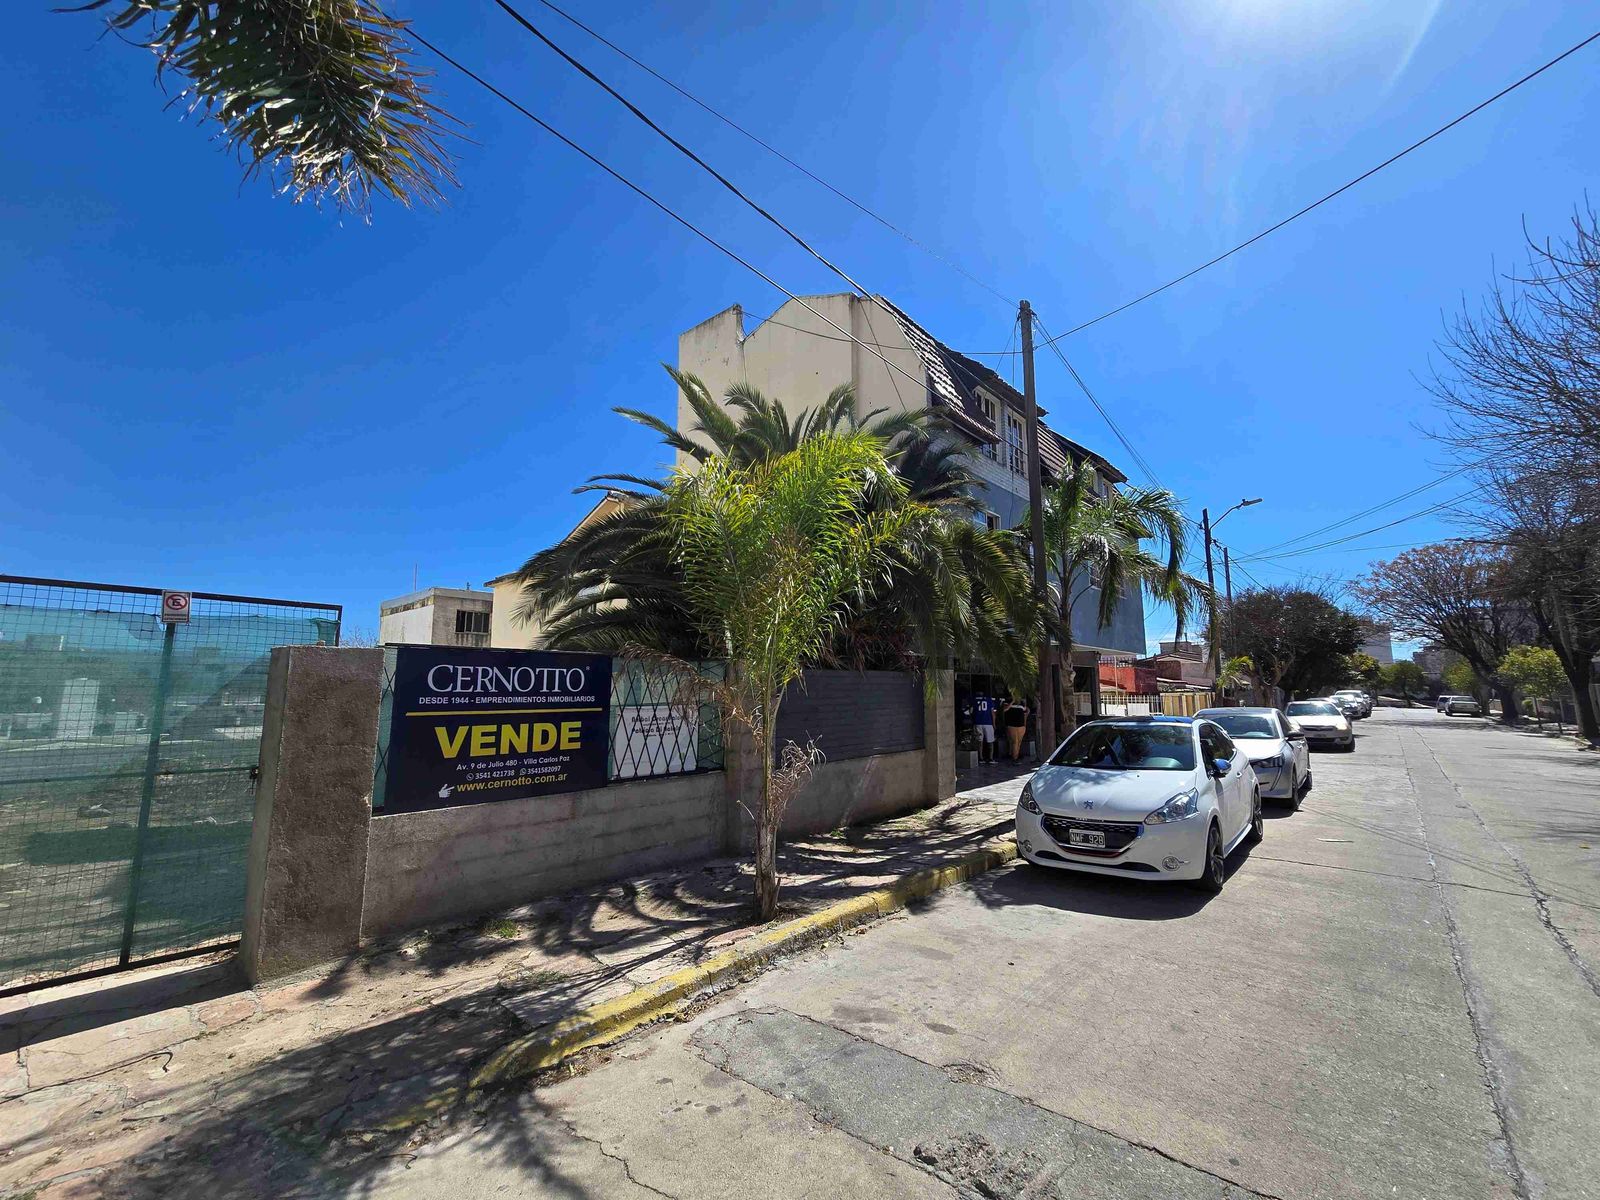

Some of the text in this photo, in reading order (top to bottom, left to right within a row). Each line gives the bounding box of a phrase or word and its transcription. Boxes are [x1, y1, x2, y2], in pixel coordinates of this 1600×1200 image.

[427, 664, 585, 693] CERNOTTO
[419, 697, 449, 705] DESDE
[451, 696, 469, 704] 1944
[475, 696, 546, 704] EMPRENDIMIENTOS
[547, 695, 596, 703] INMOBILIARIOS
[434, 721, 582, 759] VENDE
[456, 763, 469, 771] Av.
[476, 761, 487, 769] de
[488, 760, 504, 768] Julio
[505, 759, 518, 767] 480
[523, 757, 538, 765] Villa
[538, 756, 559, 764] Carlos
[456, 773, 568, 792] www.cernotto.com.ar
[475, 772, 491, 780] 3541
